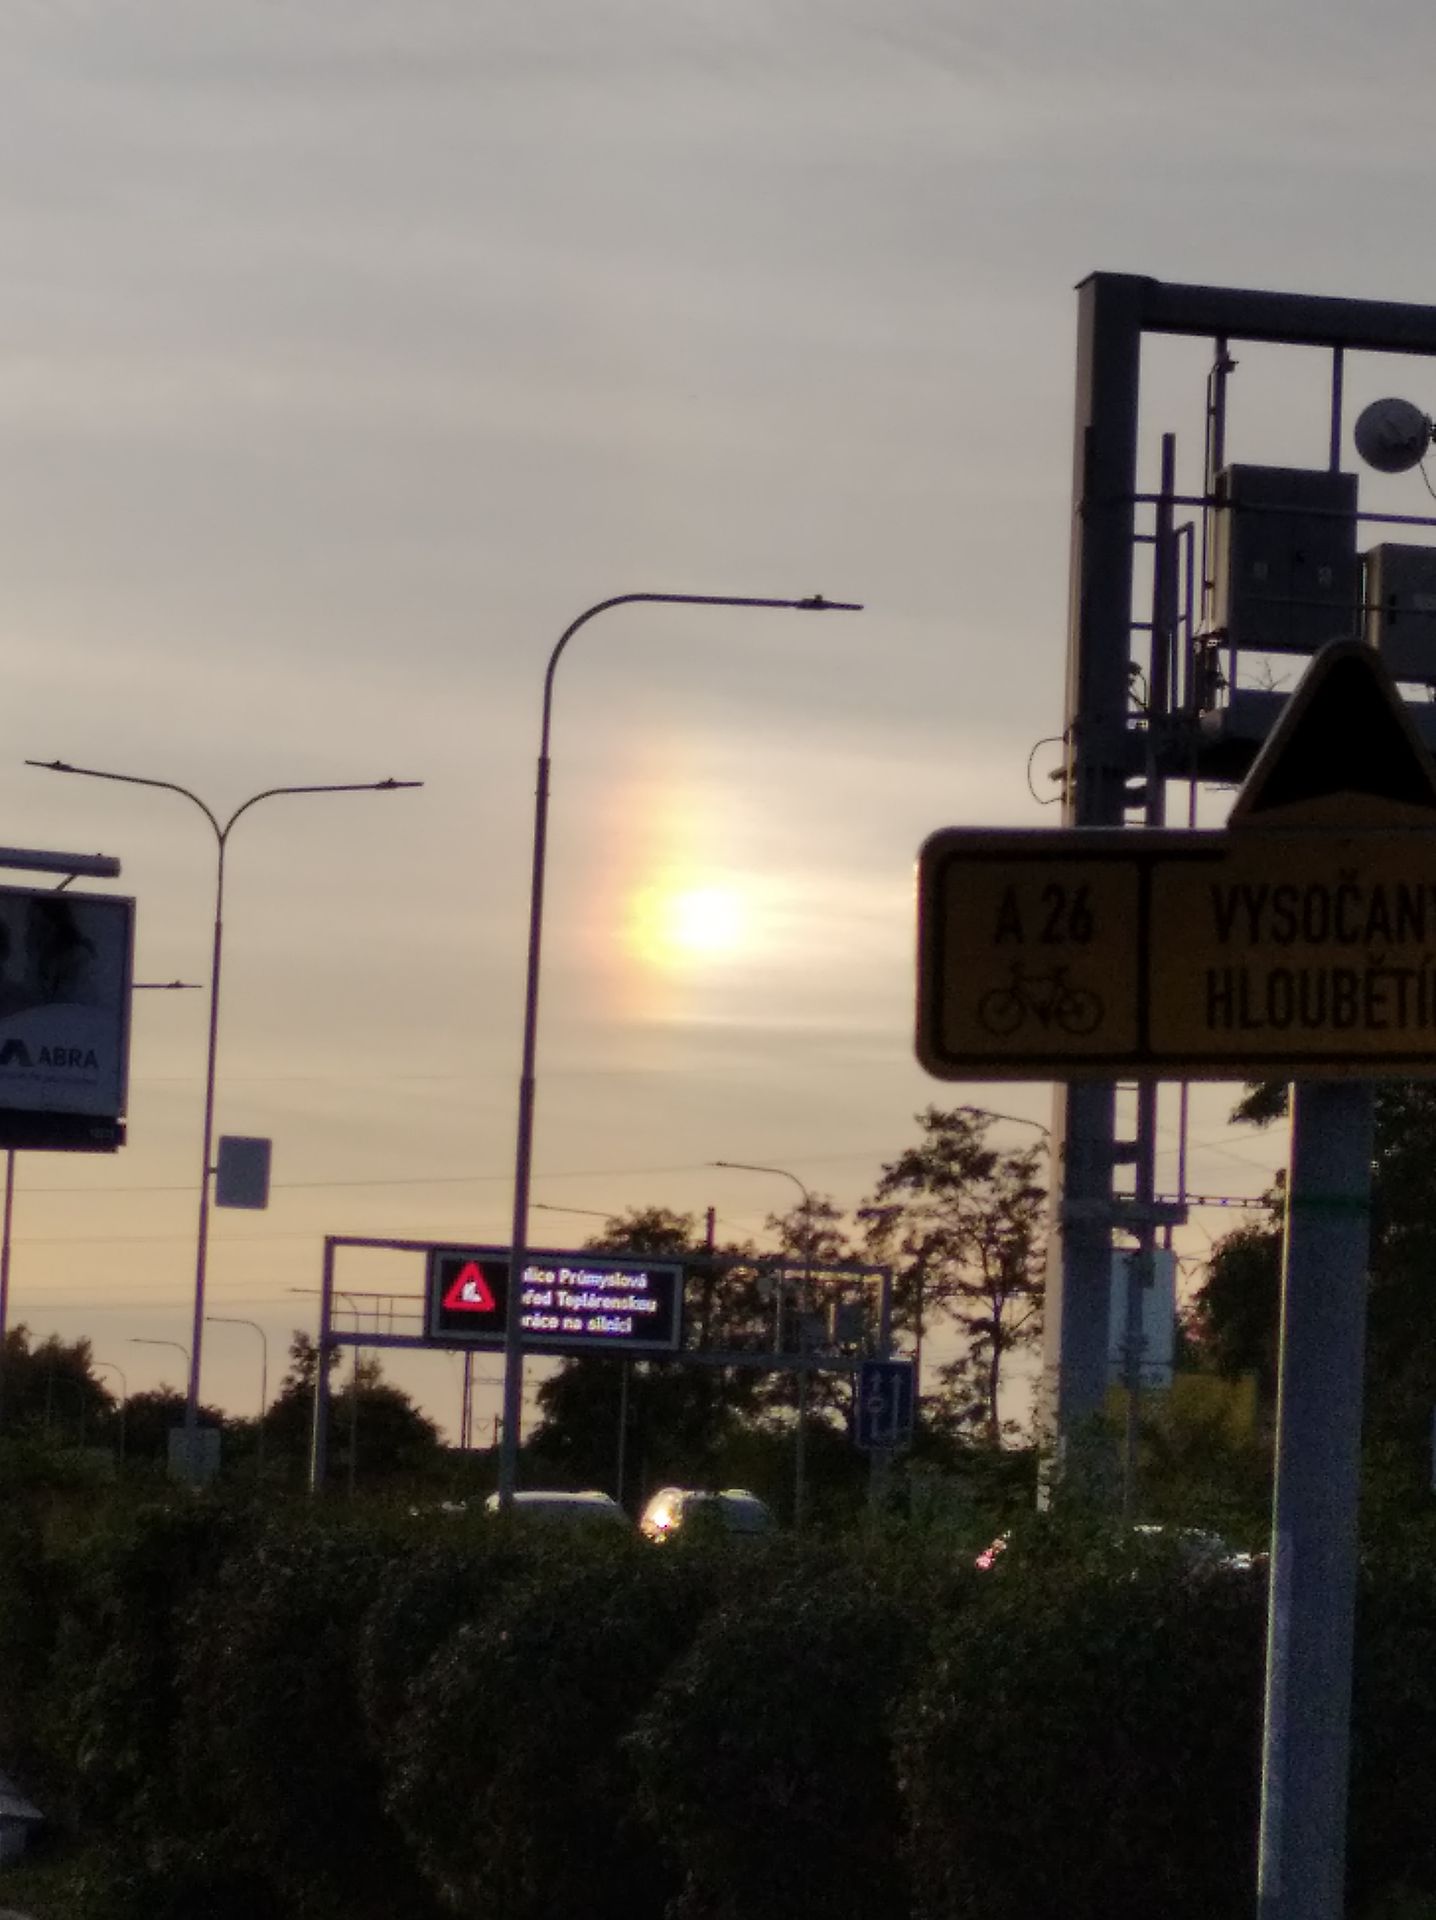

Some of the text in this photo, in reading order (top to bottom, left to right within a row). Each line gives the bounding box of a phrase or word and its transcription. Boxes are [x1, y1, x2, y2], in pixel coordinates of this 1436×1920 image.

[992, 881, 1093, 945] A 26
[1209, 868, 1436, 946] VYSOČAN
[1206, 953, 1436, 1029] HLOUBĚTÍ
[39, 1045, 98, 1069] ABRA
[563, 1317, 582, 1331] na
